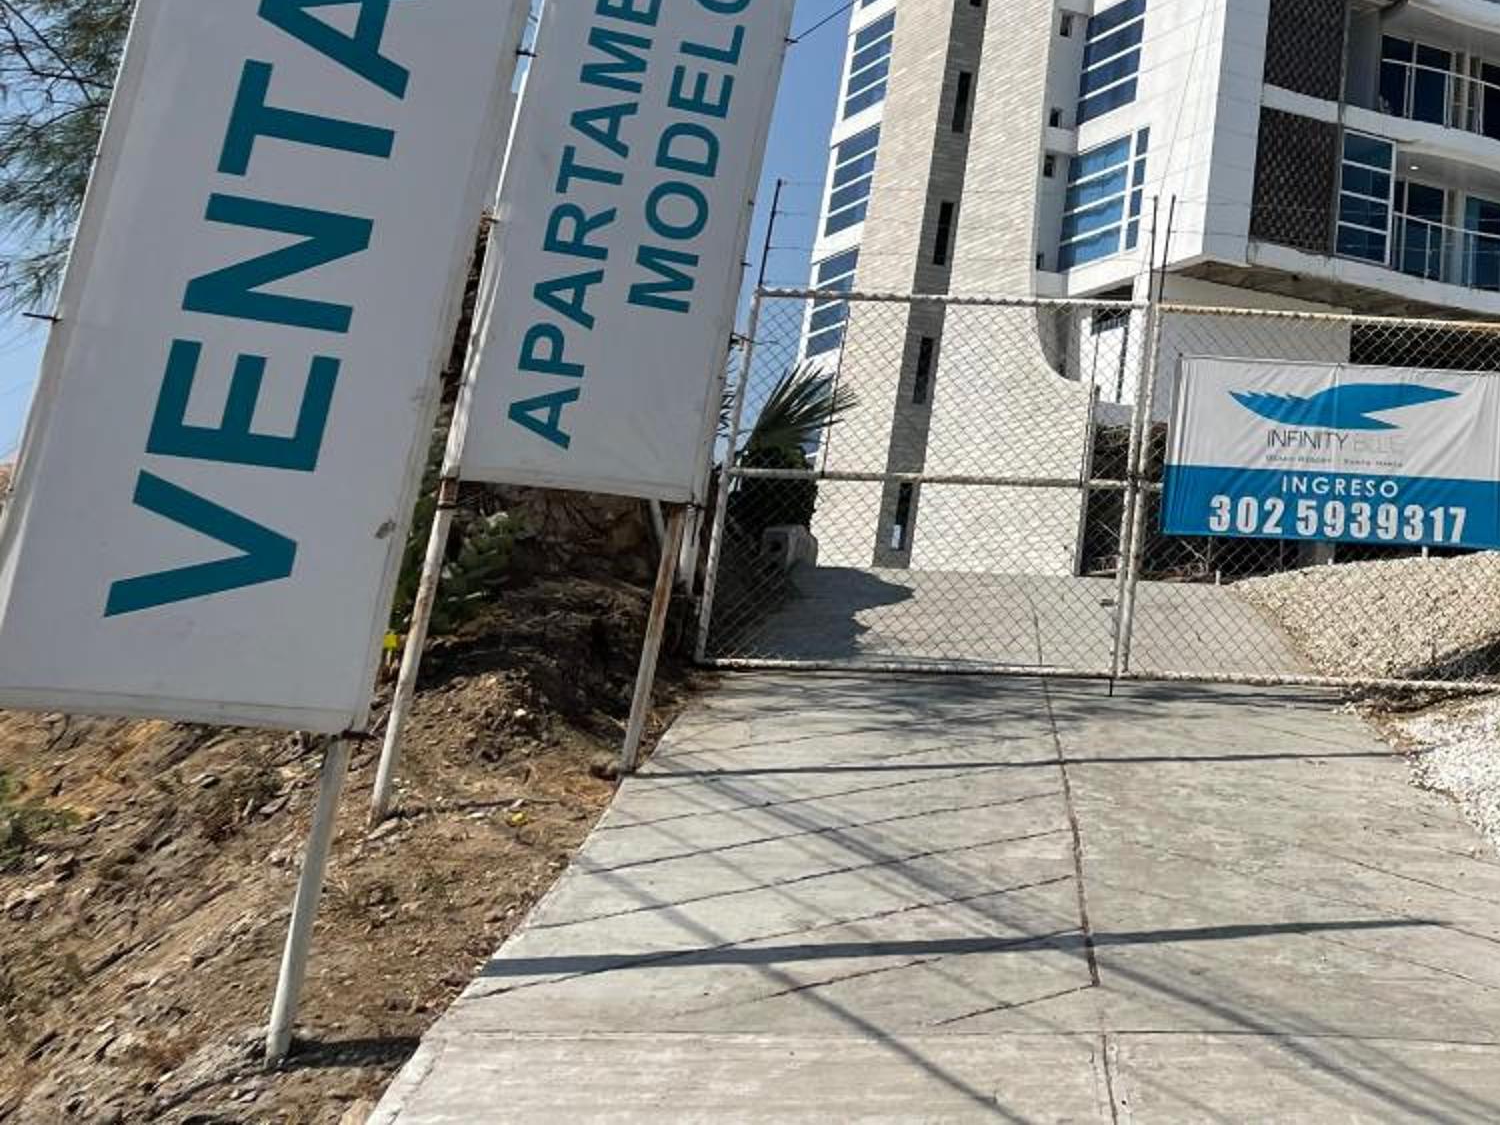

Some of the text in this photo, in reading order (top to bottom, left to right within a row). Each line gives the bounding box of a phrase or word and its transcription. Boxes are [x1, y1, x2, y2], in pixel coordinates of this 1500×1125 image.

[1266, 428, 1349, 452] INFINITY
[1281, 475, 1400, 498] INGRESO
[1208, 494, 1467, 544] 302 5939317
